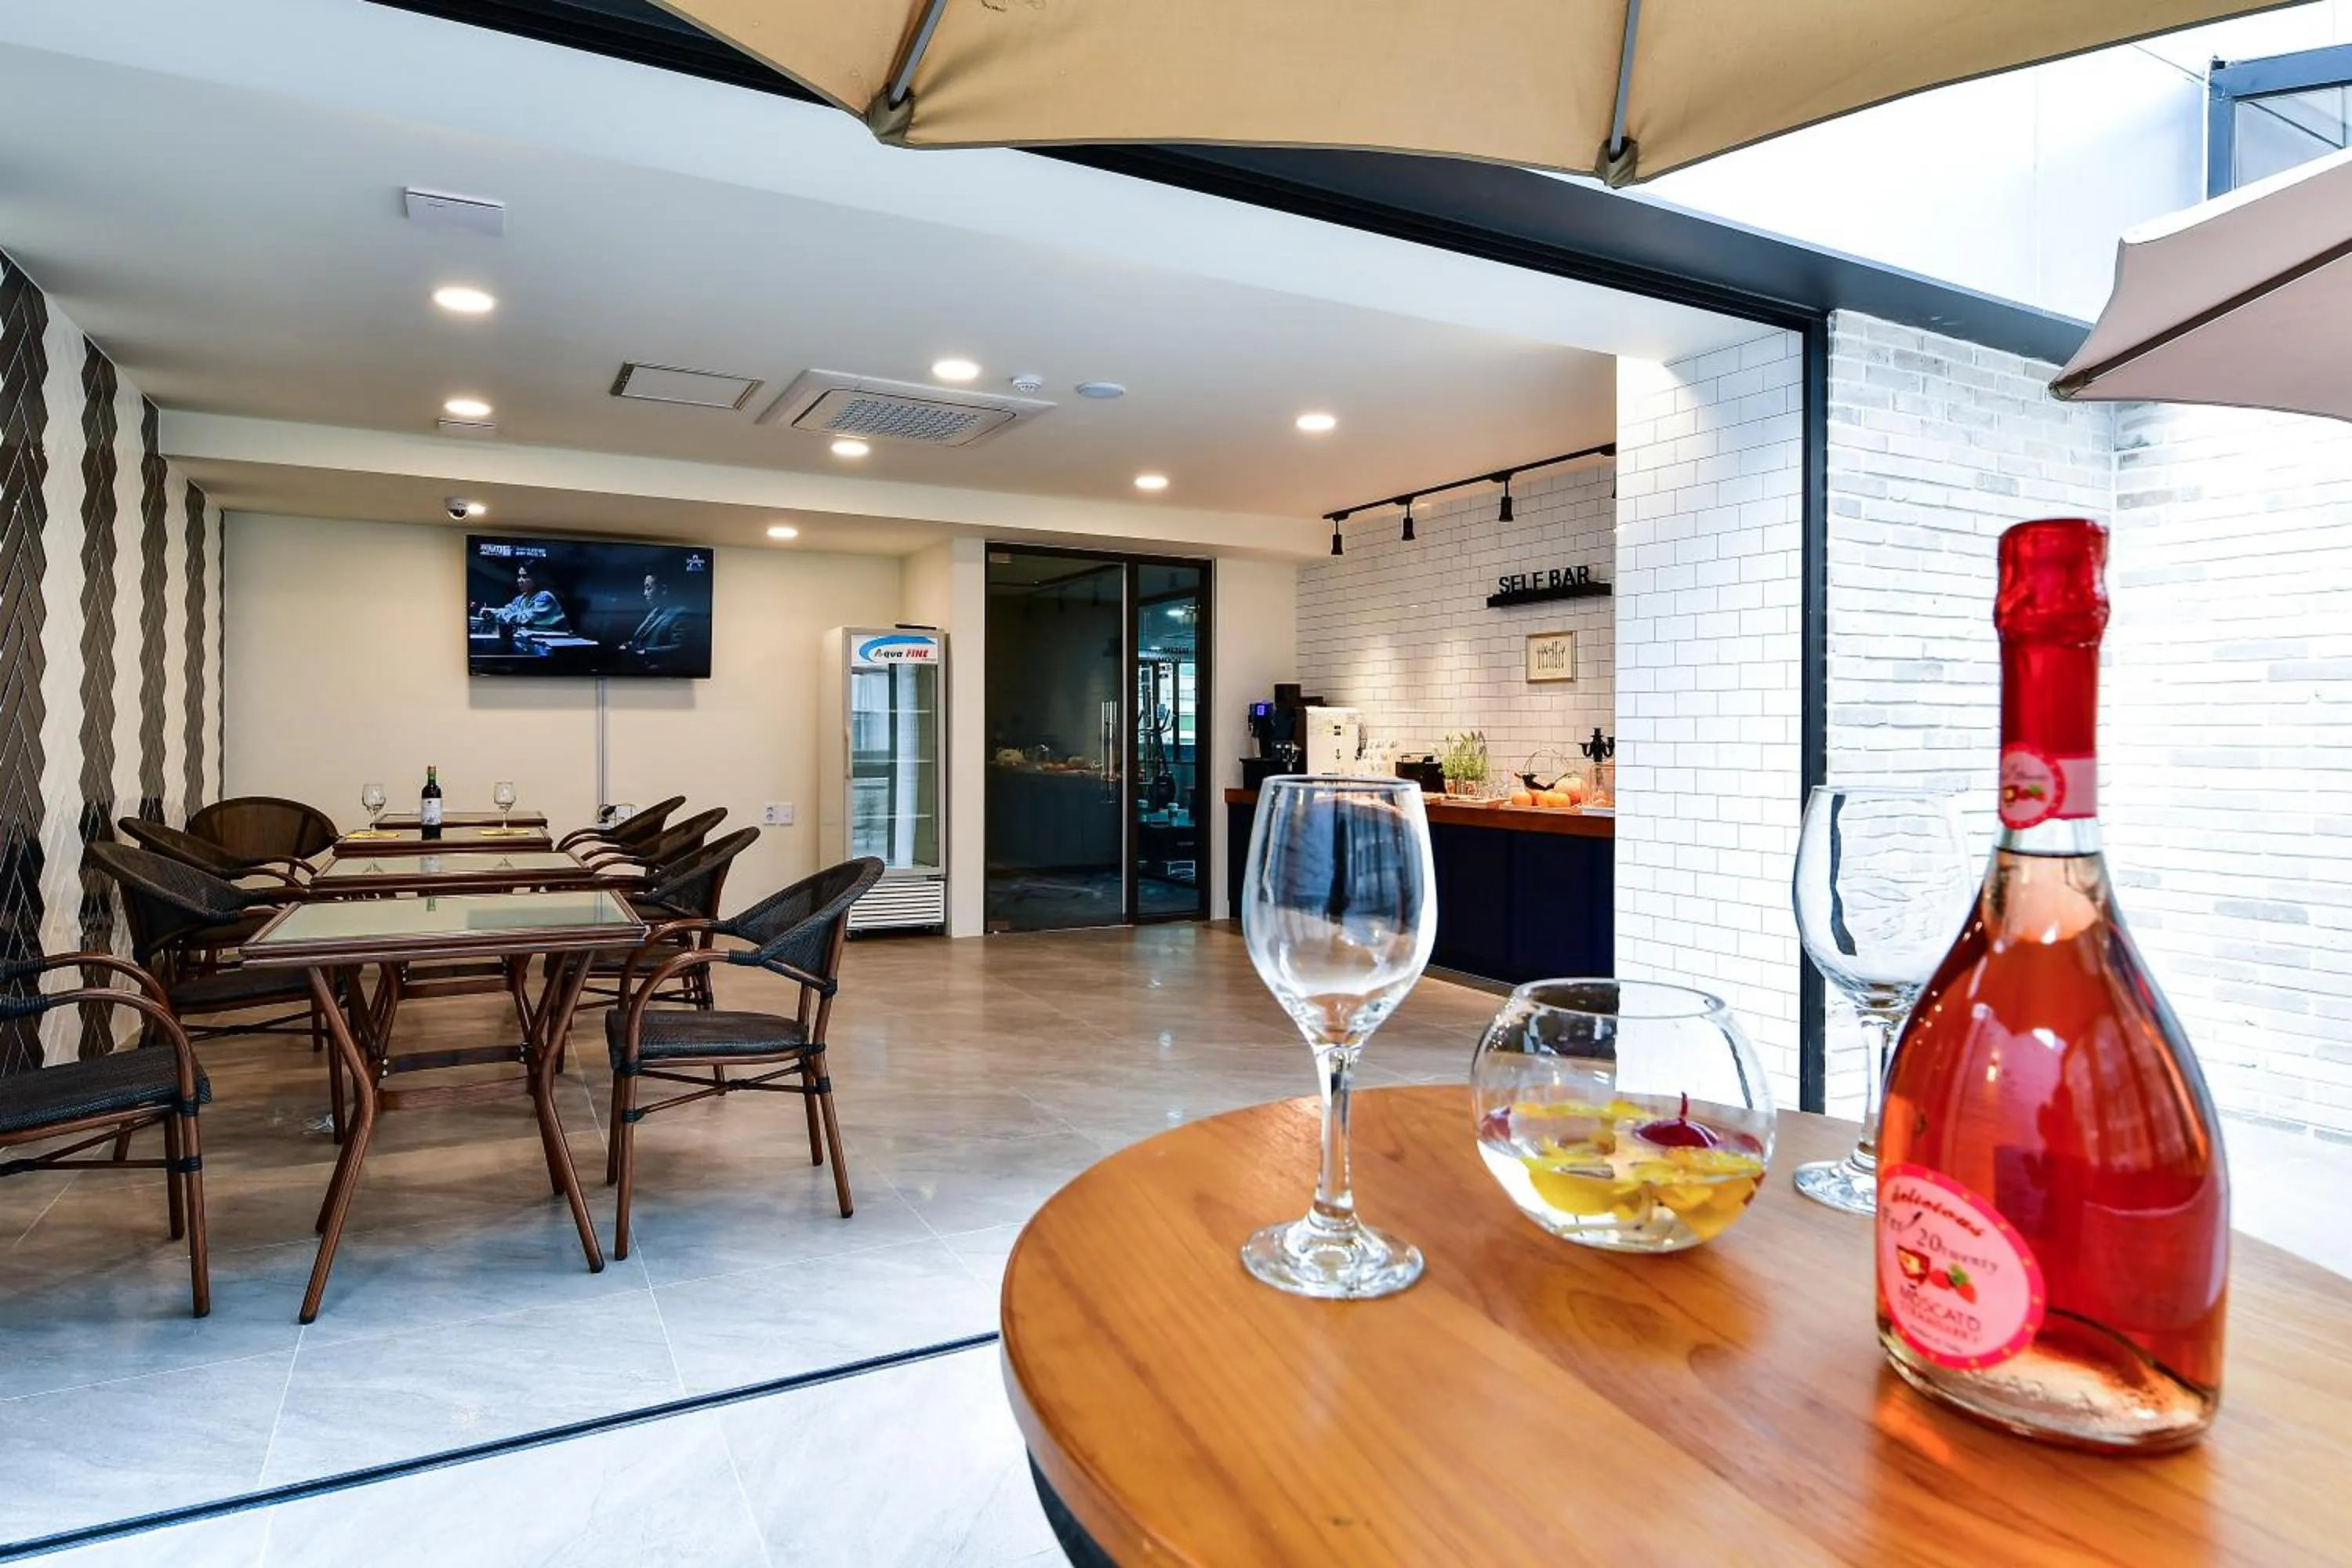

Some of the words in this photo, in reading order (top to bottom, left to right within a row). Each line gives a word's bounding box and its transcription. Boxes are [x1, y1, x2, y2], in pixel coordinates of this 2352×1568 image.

[1498, 571, 1544, 594] SELF
[1548, 565, 1590, 588] BAR
[874, 648, 903, 659] Aqua
[906, 648, 929, 659] FINE
